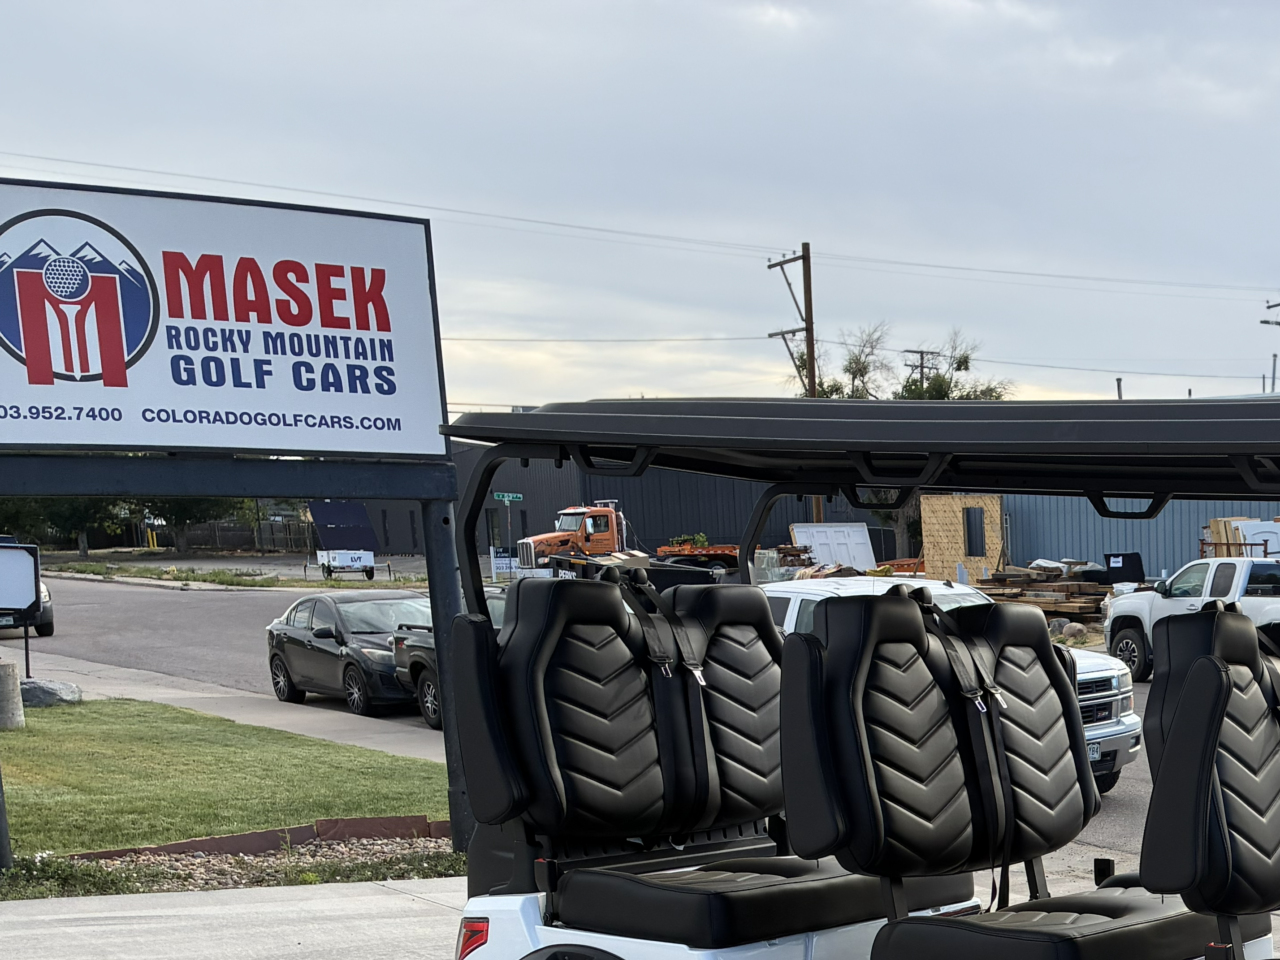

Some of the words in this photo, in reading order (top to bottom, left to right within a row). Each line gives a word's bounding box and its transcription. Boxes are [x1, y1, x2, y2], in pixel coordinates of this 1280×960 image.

[162, 250, 392, 333] MASEK
[165, 325, 252, 354] ROCKY
[262, 330, 395, 363] MOUNTAIN
[170, 354, 274, 390] GOLF
[291, 360, 398, 396] CARS
[141, 407, 402, 432] COLORADOGOLFCARS.COM
